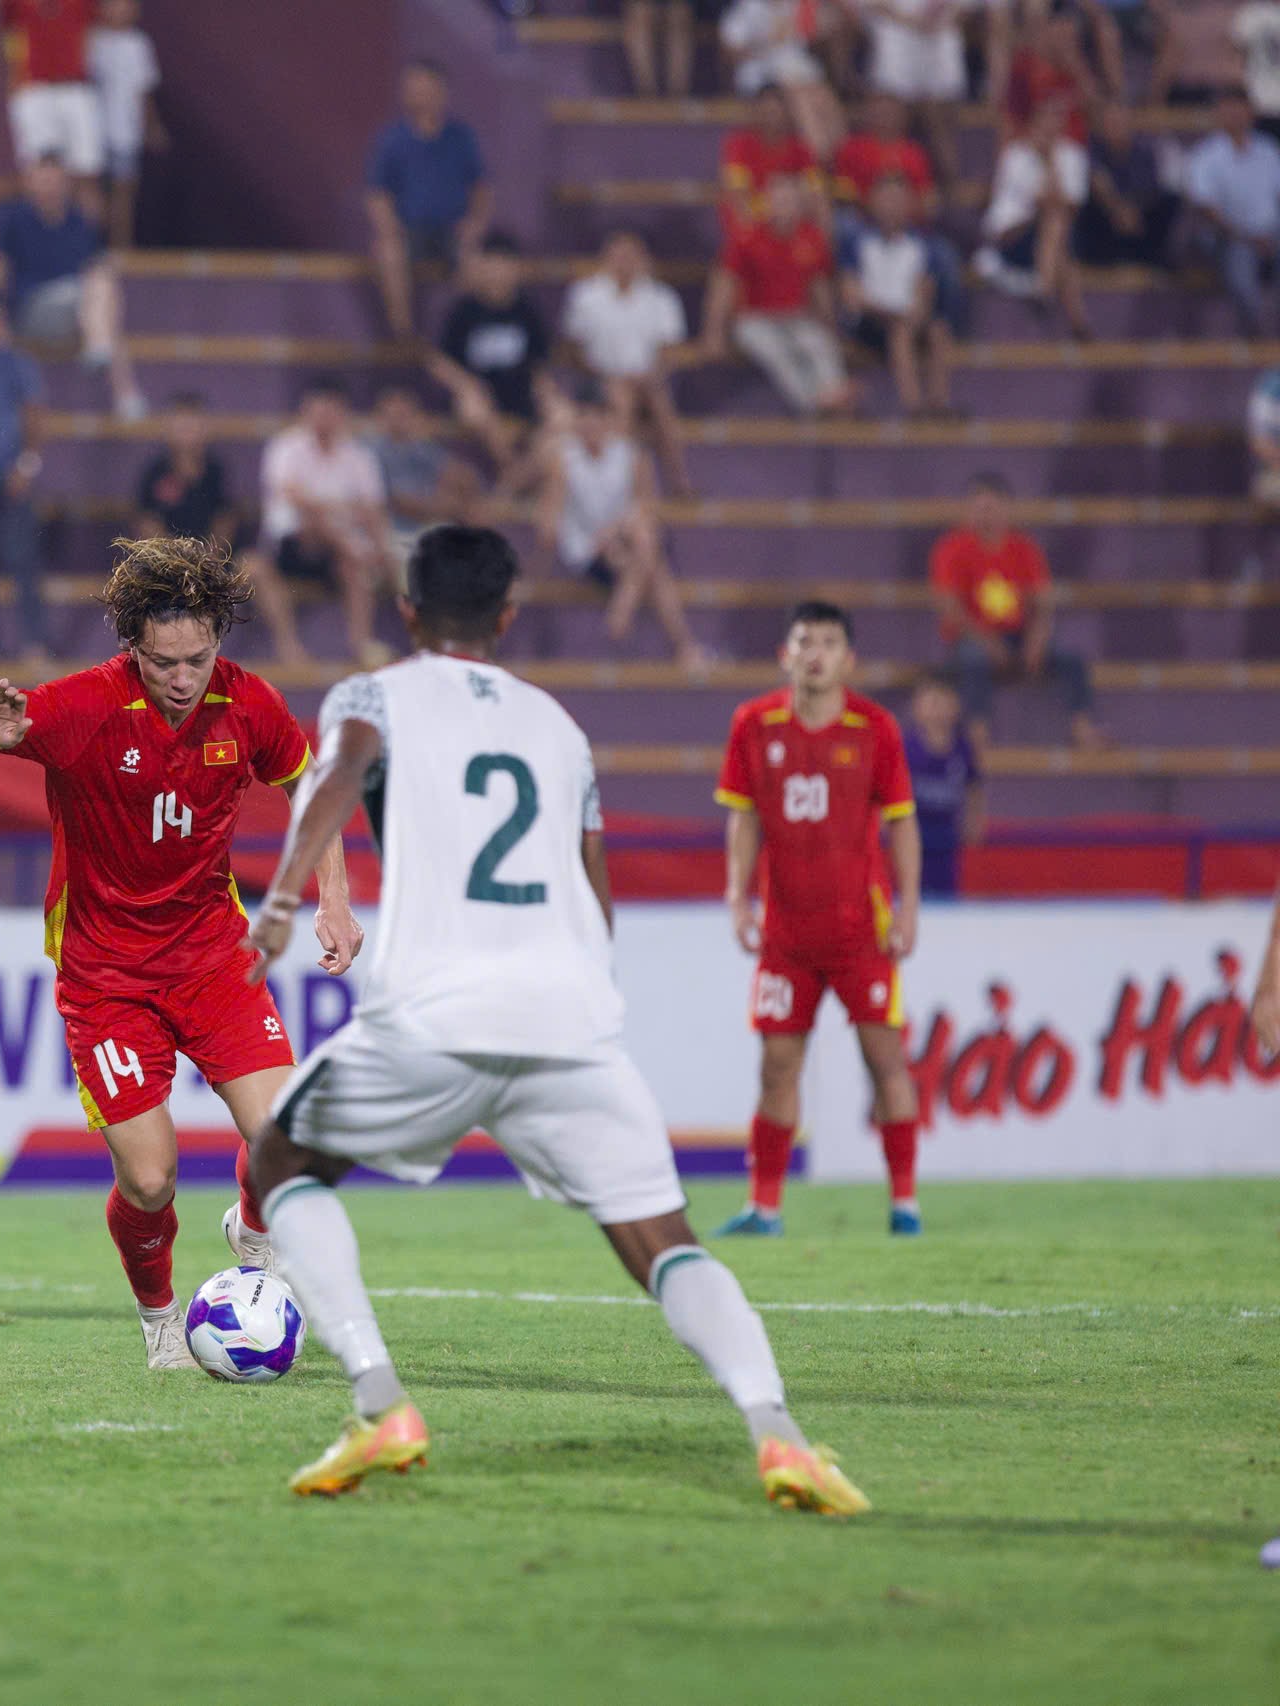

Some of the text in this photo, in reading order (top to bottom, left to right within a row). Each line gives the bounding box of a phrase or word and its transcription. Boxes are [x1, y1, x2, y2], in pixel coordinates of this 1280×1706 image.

[151, 790, 193, 844] 14
[464, 752, 547, 904] 2
[92, 1037, 145, 1100] 14
